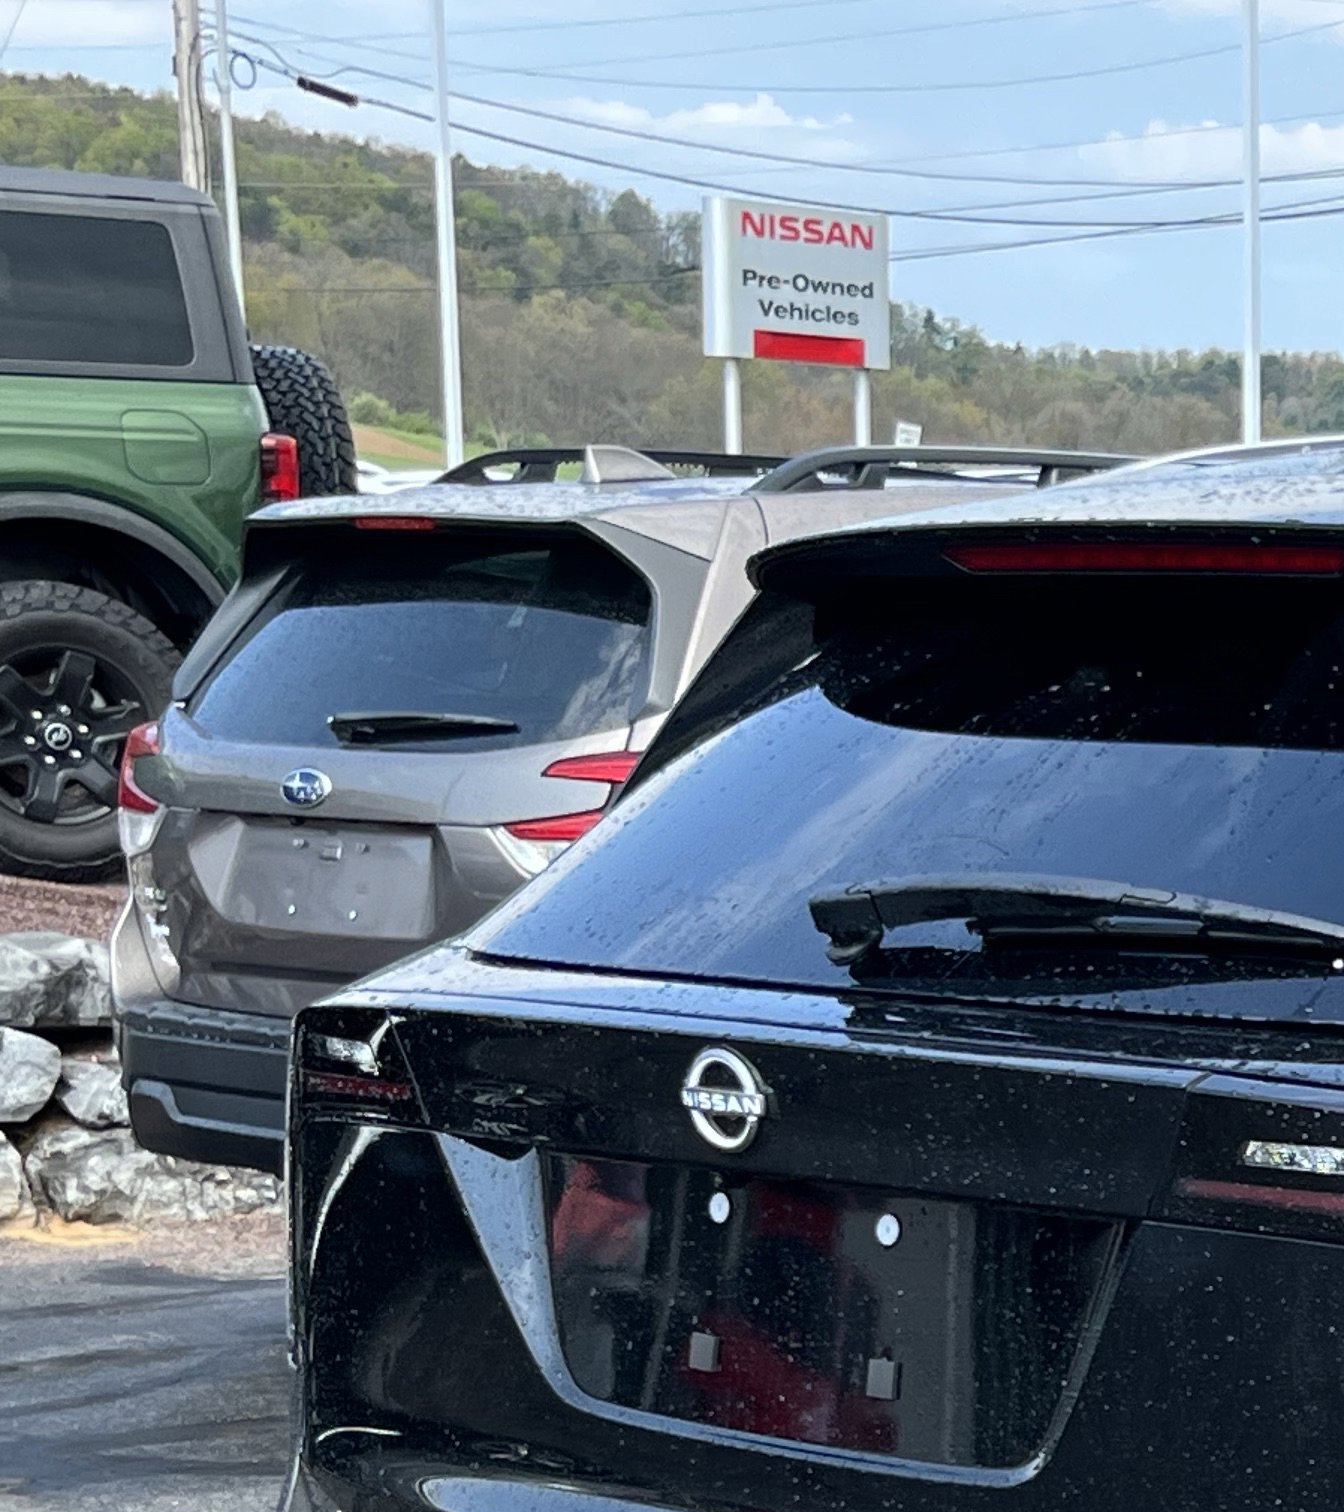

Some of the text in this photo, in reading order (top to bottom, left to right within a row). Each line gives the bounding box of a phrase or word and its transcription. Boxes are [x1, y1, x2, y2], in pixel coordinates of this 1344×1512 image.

[741, 210, 873, 251] NISSAN
[742, 269, 873, 299] Pre-Owned
[758, 298, 859, 326] Vehicles
[682, 1089, 762, 1115] NISSAN
